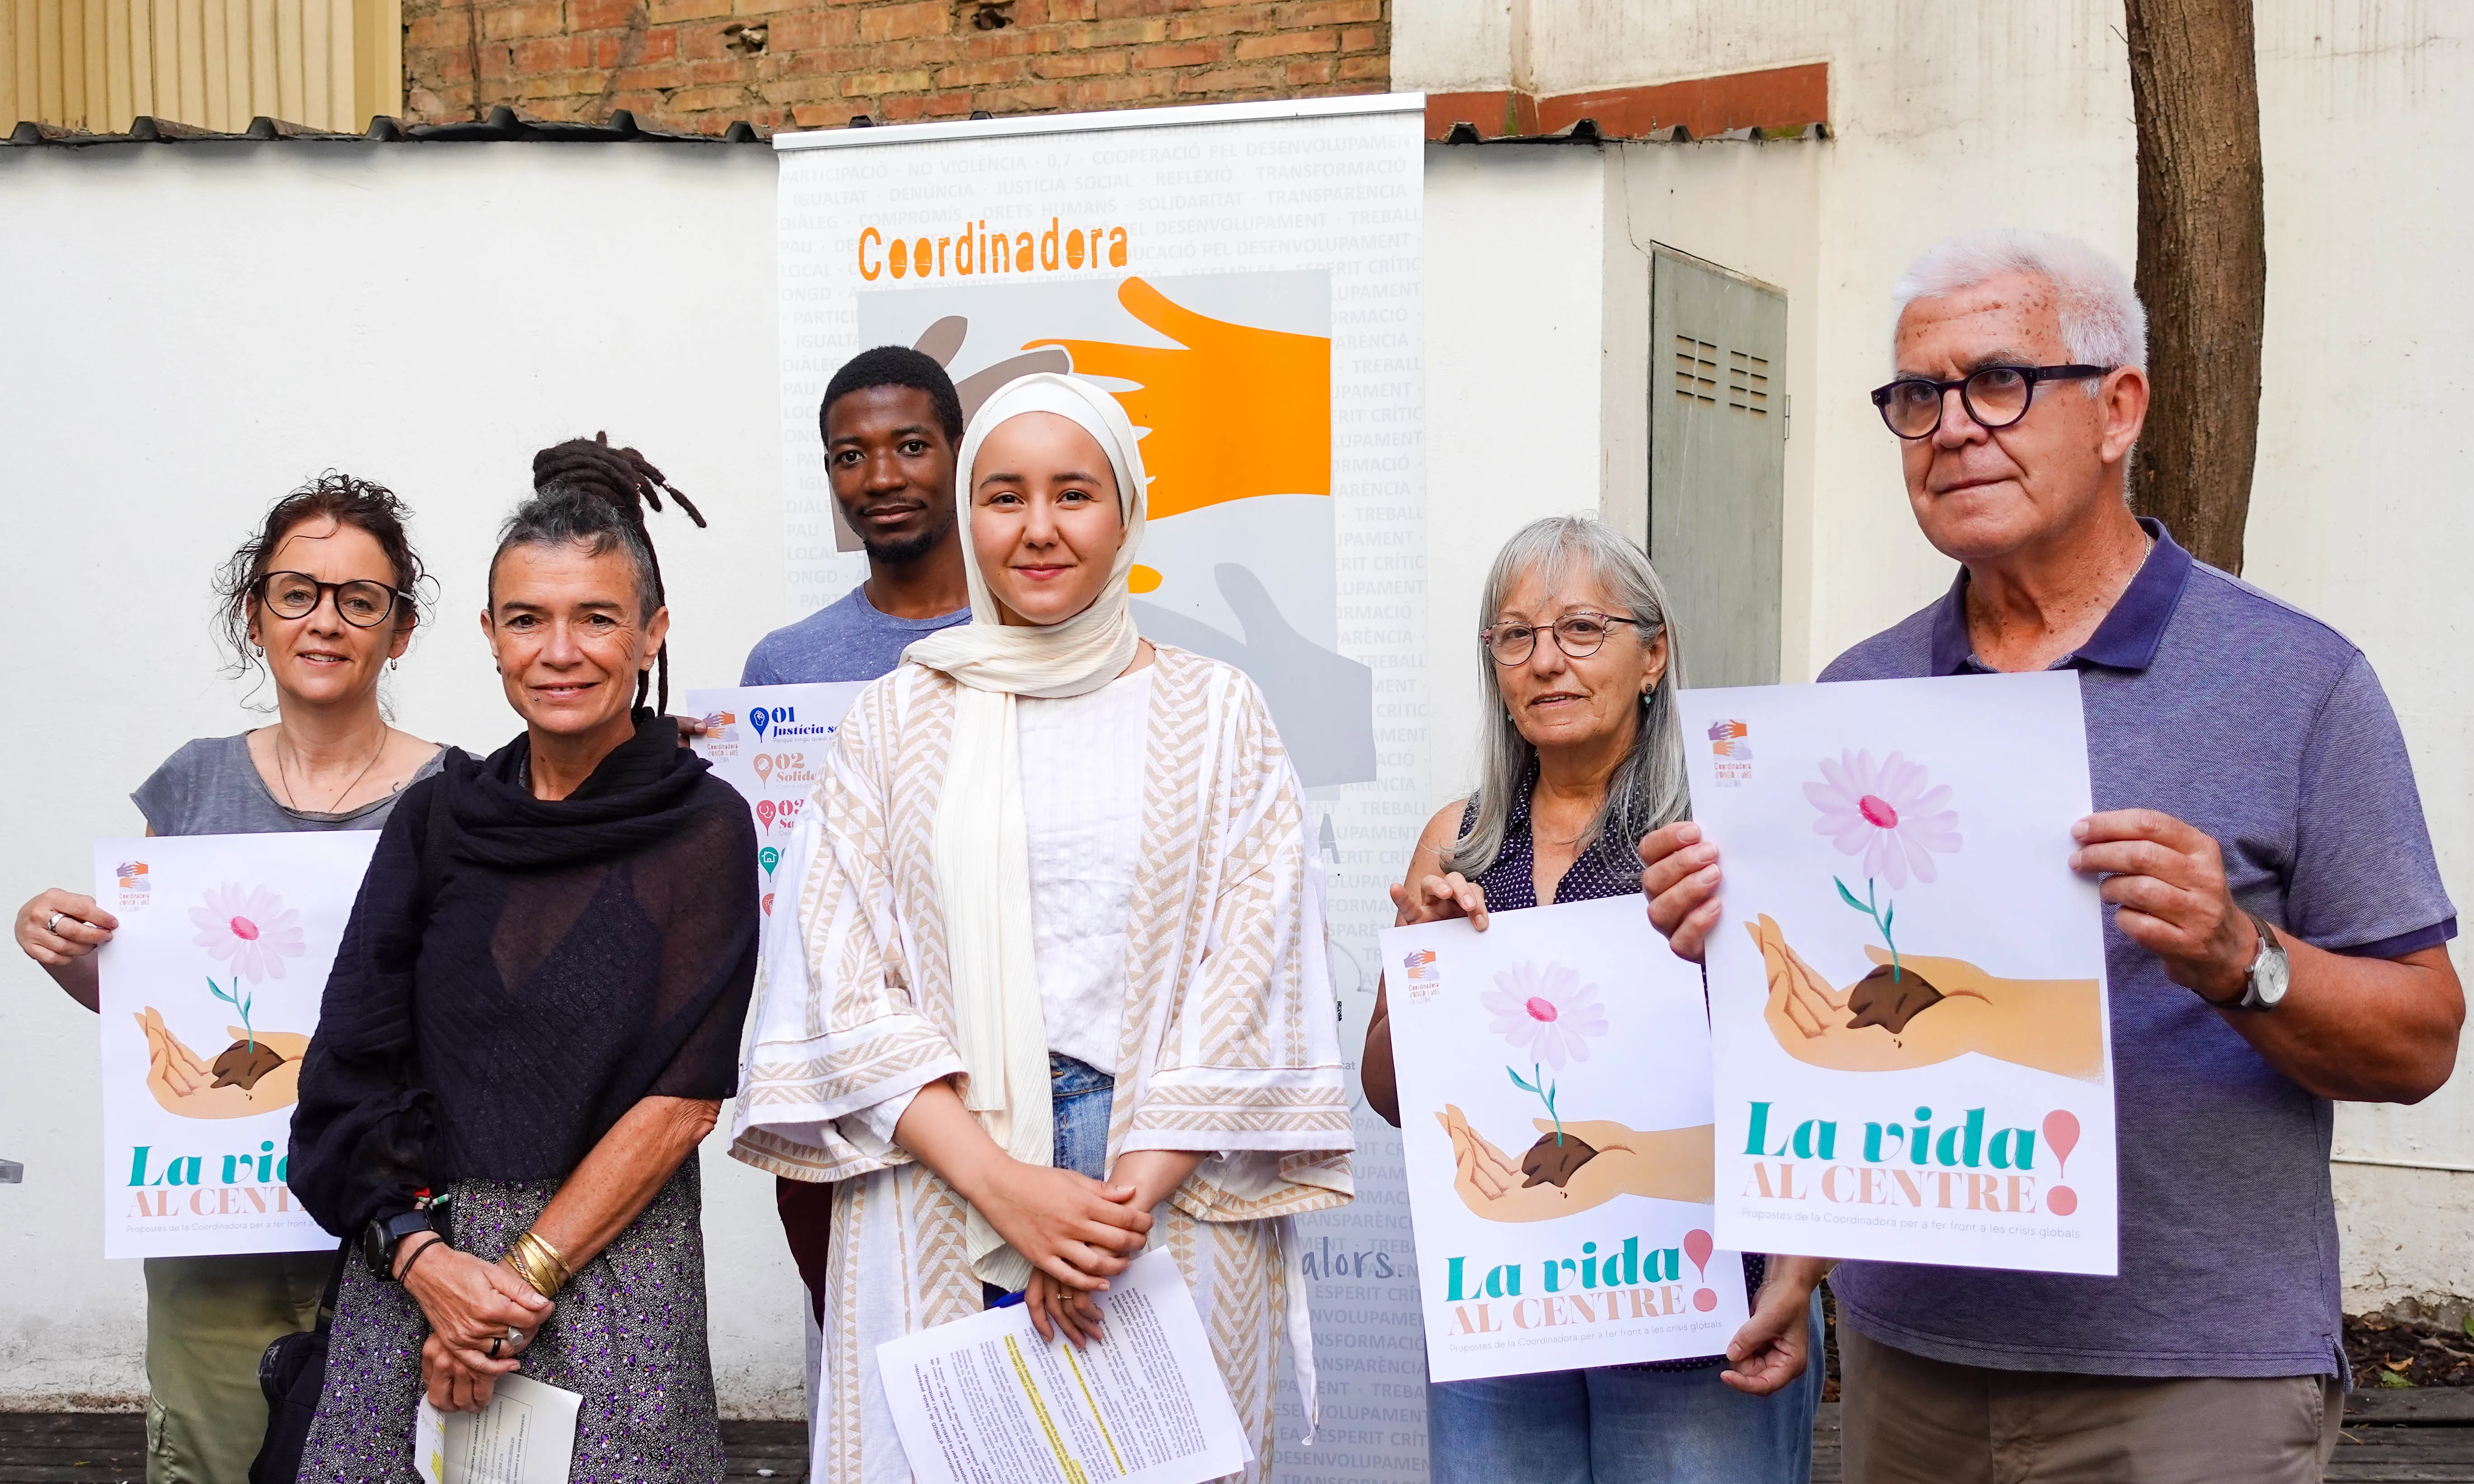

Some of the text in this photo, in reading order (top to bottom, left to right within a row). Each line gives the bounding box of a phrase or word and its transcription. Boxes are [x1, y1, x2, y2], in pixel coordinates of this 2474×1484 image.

[793, 156, 1407, 207] IGUALTAT DENÚNCIA JUSTÍCIA SOCIAL REFLEXIÓ TRANSFORMACIÓ
[780, 182, 1407, 230] DIÀLEG COMPROMÍS DRETS HUMANS SOLIDARITAT TRANSPARÈNCIA
[859, 217, 1127, 281] Coordinadora
[793, 310, 855, 325] PARTICI
[796, 334, 859, 348] IGUALTA
[1351, 356, 1421, 374] TREBALL
[1371, 403, 1422, 423] CRÍTIC
[1354, 505, 1423, 522] TREBALL
[1373, 553, 1425, 570] CRÍTIC
[772, 707, 796, 723] 01
[773, 724, 823, 738] Justícia
[775, 753, 805, 769] 02
[1741, 1101, 1837, 1160] La
[126, 1146, 202, 1187] La
[1741, 1161, 2037, 1214] AL CENTRE
[127, 1186, 307, 1217] AL CENT
[127, 1225, 166, 1235] Propostes
[192, 1222, 247, 1231] Coordinadora
[250, 1222, 263, 1230] per
[1741, 1207, 1791, 1221] Propostes
[1794, 1211, 1808, 1220] de
[1811, 1212, 1820, 1221] la
[1823, 1212, 1896, 1226] Coordinadora
[1900, 1220, 1918, 1230] per
[1932, 1220, 1946, 1230] fer
[1950, 1220, 1976, 1232] front
[1990, 1223, 2005, 1234] les
[2008, 1225, 2035, 1236] crisis
[2040, 1228, 2080, 1239] globals
[1302, 1235, 1402, 1281] alors.
[1444, 1256, 1522, 1302] La
[1447, 1284, 1686, 1336] AL CENTRE
[1449, 1342, 1492, 1353] Propostes
[1518, 1333, 1577, 1347] Coordinadora
[1580, 1333, 1594, 1343] per
[1620, 1328, 1641, 1337] front
[1652, 1326, 1664, 1334] les
[1667, 1323, 1688, 1333] crisis
[1690, 1319, 1722, 1332] globals
[1372, 1382, 1425, 1399] TREBA
[1390, 1430, 1427, 1448] CRÍT
